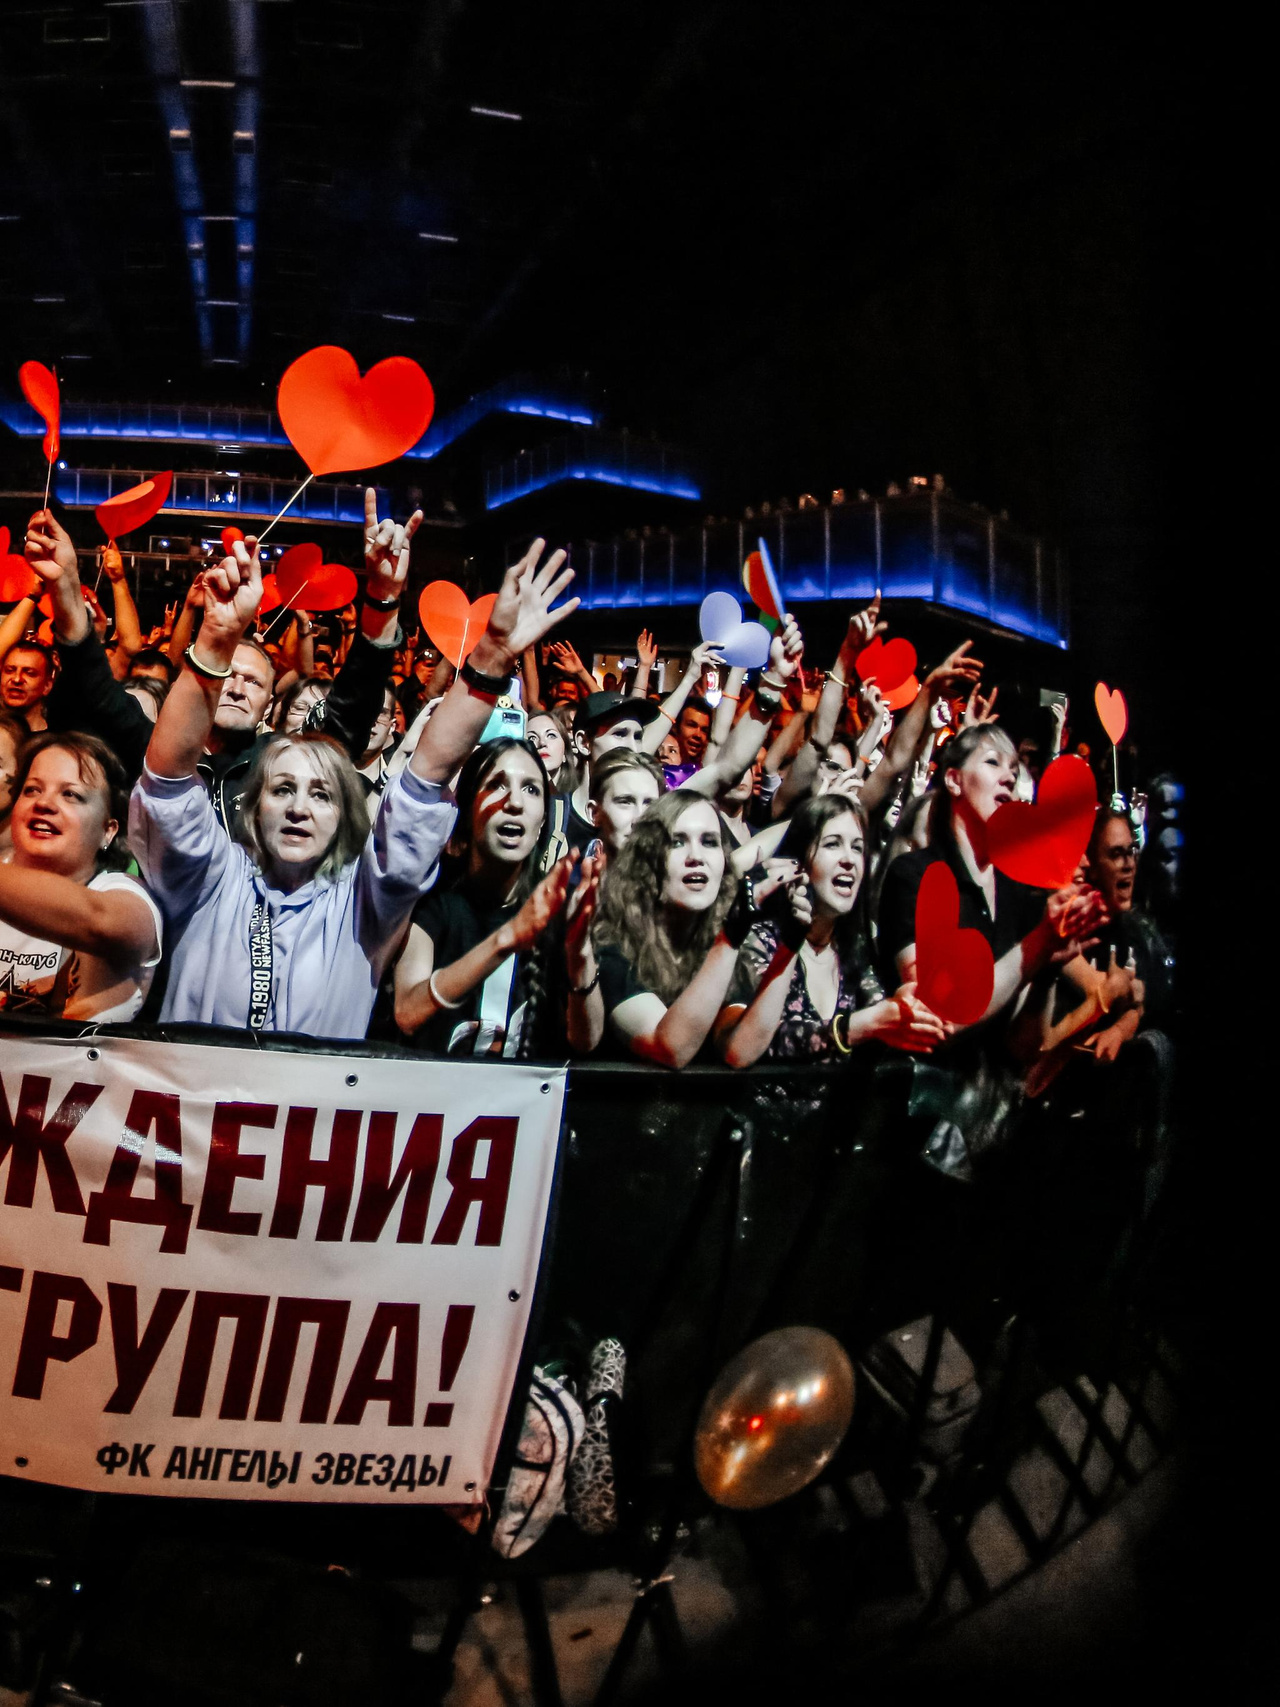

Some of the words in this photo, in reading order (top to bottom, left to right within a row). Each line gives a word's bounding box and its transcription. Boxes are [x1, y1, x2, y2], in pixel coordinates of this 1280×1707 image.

[96, 1442, 156, 1477] ФК
[163, 1445, 302, 1486] АНГЕЛЫ
[312, 1452, 452, 1493] ЗВЕЗДЫ
